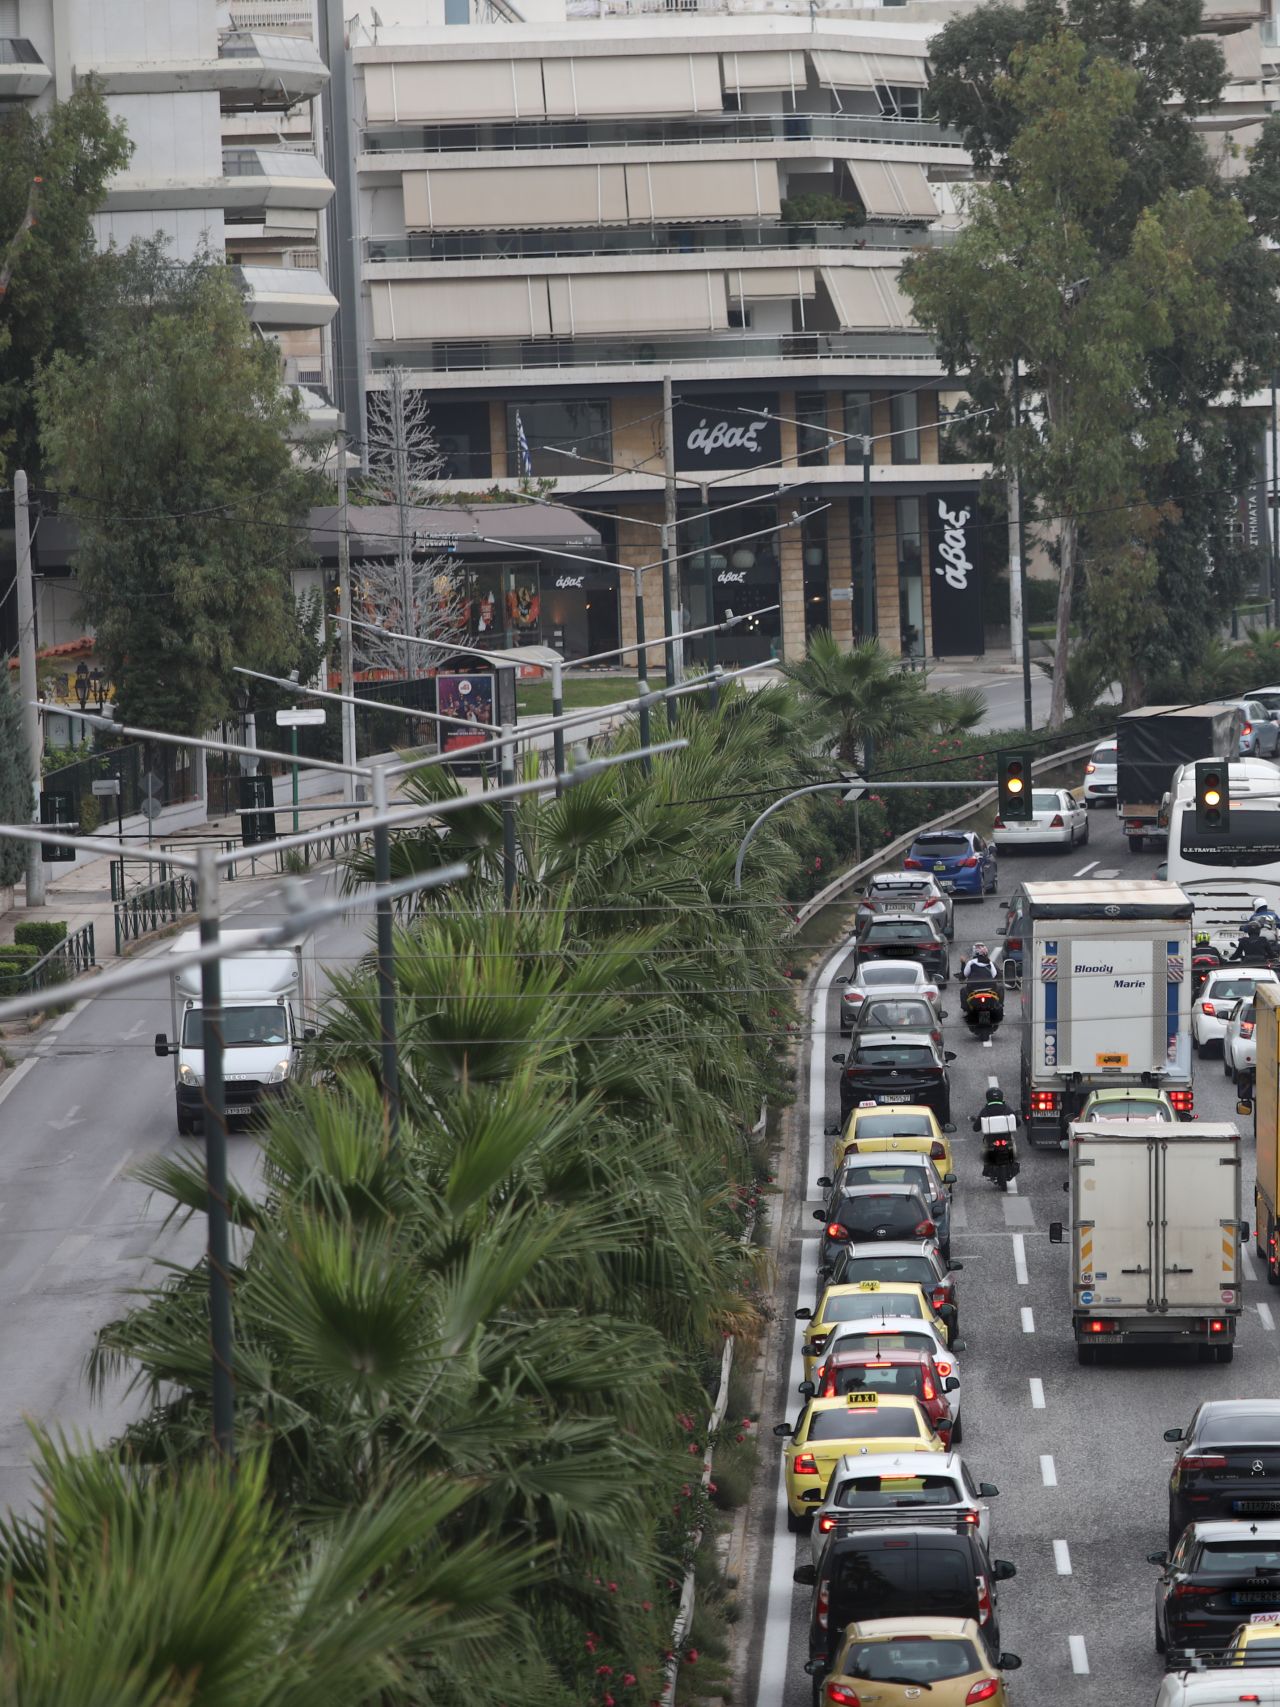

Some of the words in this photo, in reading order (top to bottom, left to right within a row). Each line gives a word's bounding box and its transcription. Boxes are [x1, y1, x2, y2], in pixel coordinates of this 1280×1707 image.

[1074, 965, 1113, 974] Bloody
[1114, 980, 1145, 988] Marie
[1253, 1614, 1279, 1624] TAXI
